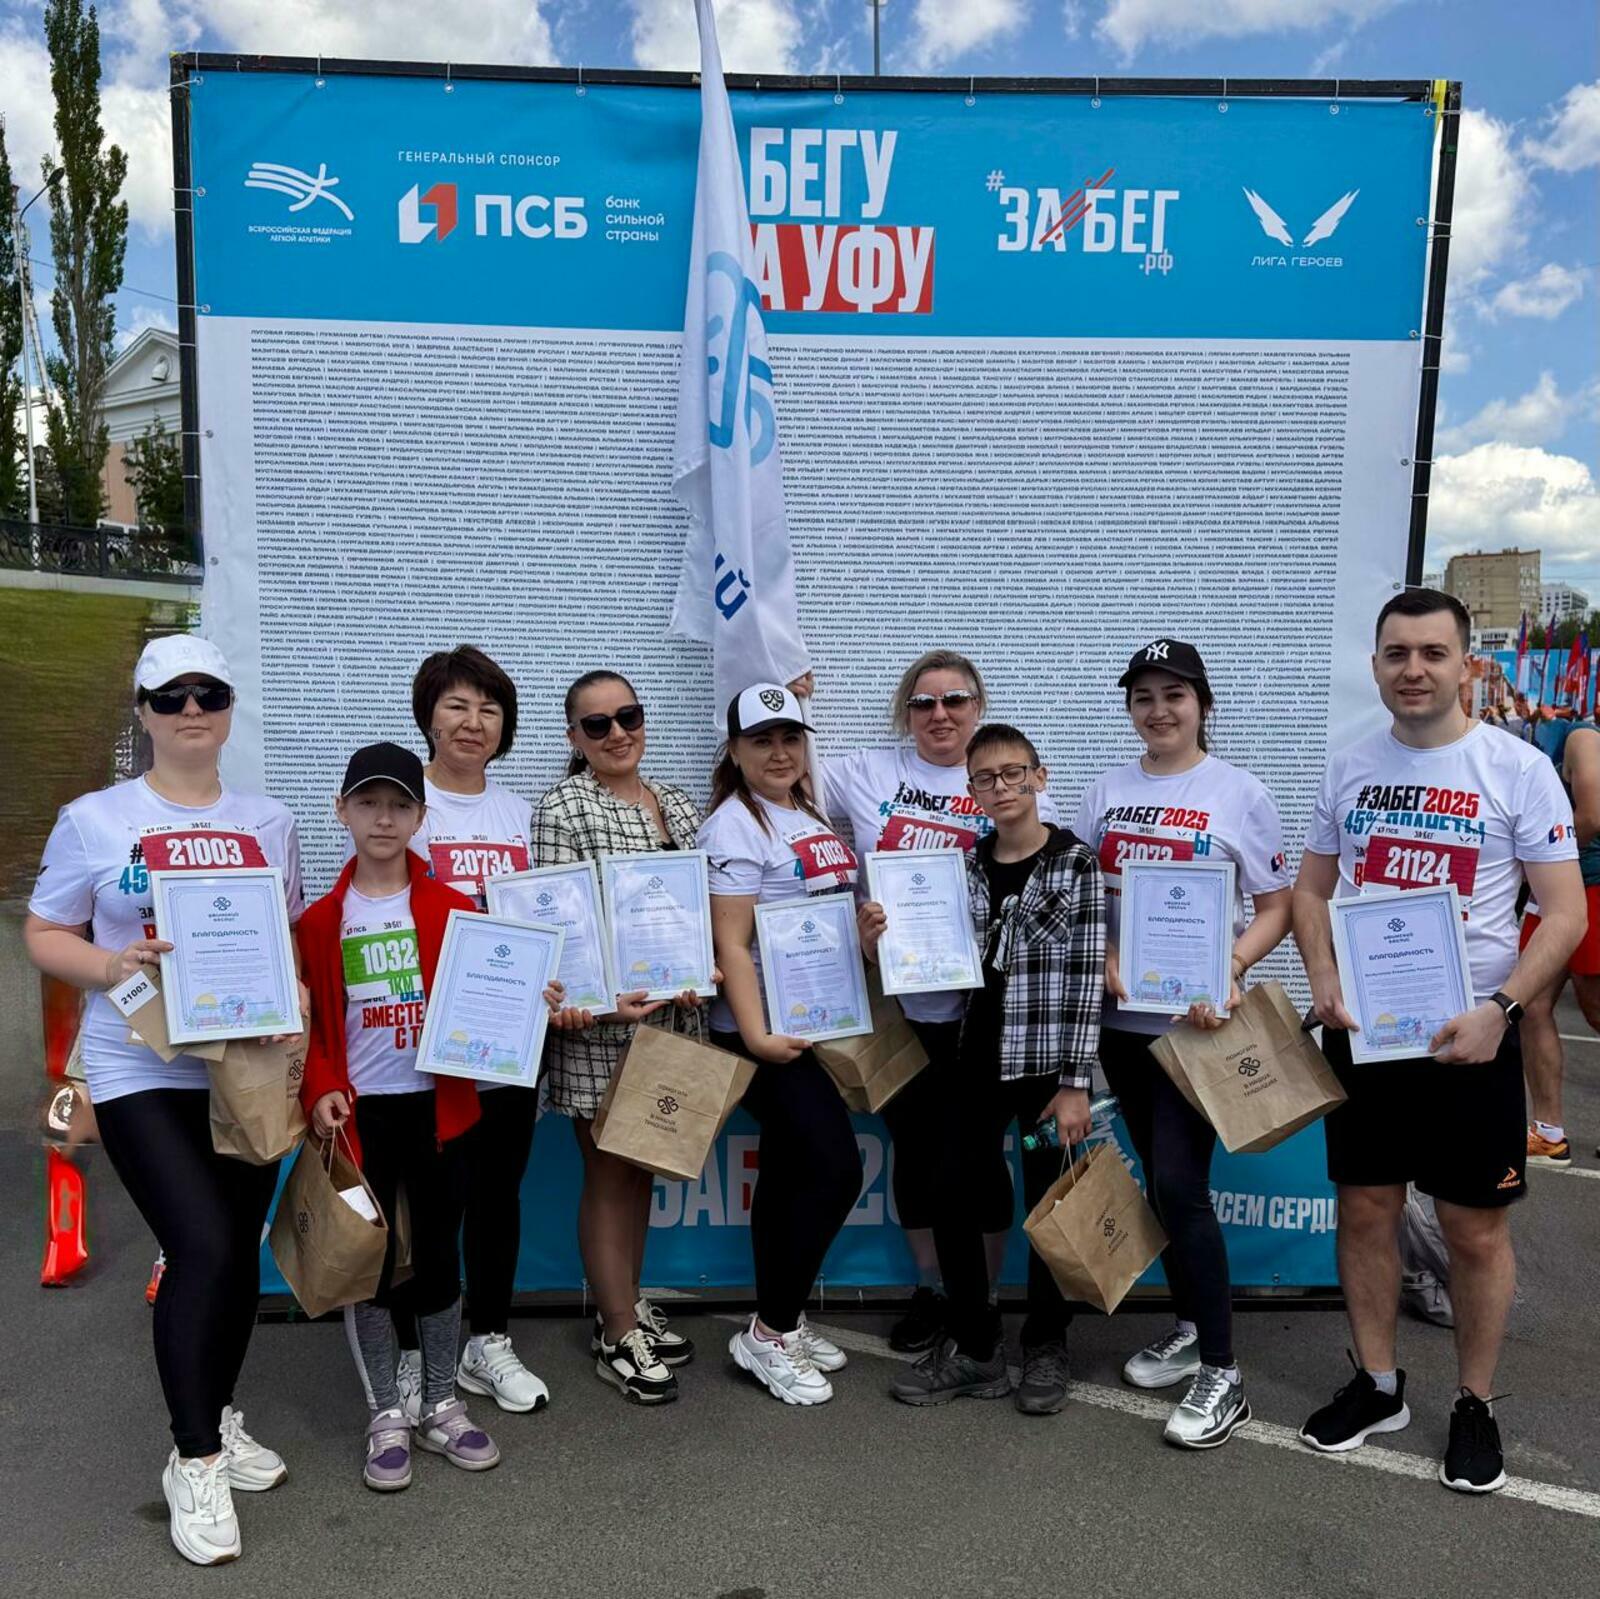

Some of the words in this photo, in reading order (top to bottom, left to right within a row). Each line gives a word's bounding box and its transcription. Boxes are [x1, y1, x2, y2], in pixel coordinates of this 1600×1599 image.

[398, 151, 495, 165] ГЕНЕРАЛЬНЫЙ
[500, 153, 561, 167] СПОНСОР
[750, 127, 898, 218] БЕГУ
[606, 195, 640, 209] банк
[475, 194, 588, 239] ПСБ
[605, 211, 665, 226] сильной
[605, 228, 659, 243] страны
[750, 223, 786, 311] А
[800, 224, 935, 313] УФУ
[1251, 256, 1287, 266] ЛИГА
[1291, 256, 1344, 267] ГЕРОЕВ
[1356, 784, 1481, 819] #ЗАБЕГ2025
[1104, 806, 1210, 831] #ЗАБЕГ2025
[1344, 809, 1379, 836] 45%
[166, 837, 244, 867] 21003
[449, 849, 516, 878] 20734
[1384, 846, 1451, 886] 21124
[118, 865, 149, 895] 45
[1147, 916, 1206, 925] БЛАГОДАРНОСТЬ
[191, 929, 259, 938] БЛАГОДАРНОСТЬ
[1368, 948, 1434, 961] БЛАГОДАРНОСТЬ
[466, 971, 527, 986] БЛАГОДАРНОСТЬ
[120, 981, 148, 1006] 21003
[362, 1001, 424, 1029] ВМЕСТЕ
